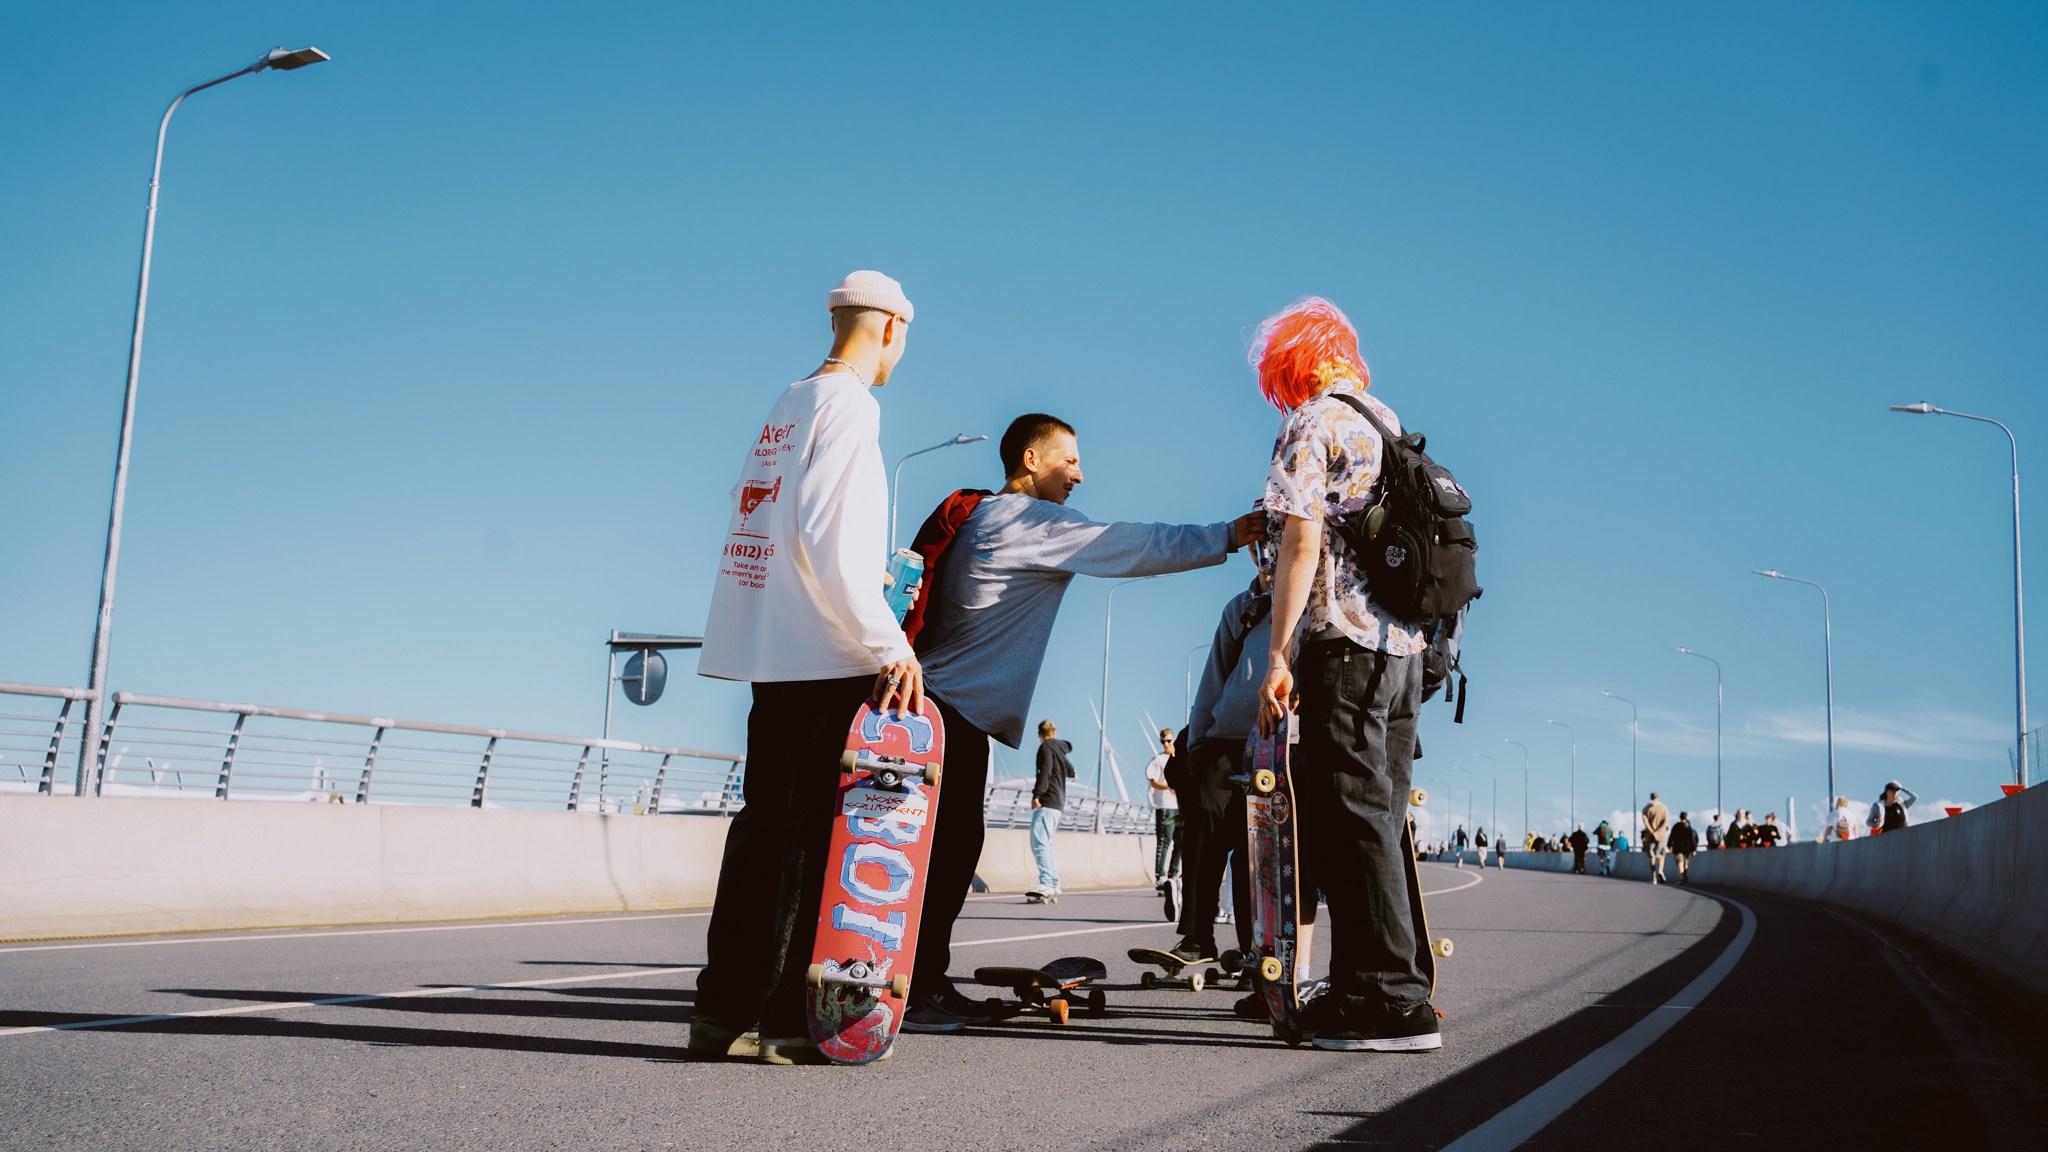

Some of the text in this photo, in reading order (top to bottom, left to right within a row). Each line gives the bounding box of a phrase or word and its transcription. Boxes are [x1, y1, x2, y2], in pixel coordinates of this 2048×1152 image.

[730, 543, 762, 561] (812)
[733, 561, 749, 570] Take
[732, 571, 753, 579] men's
